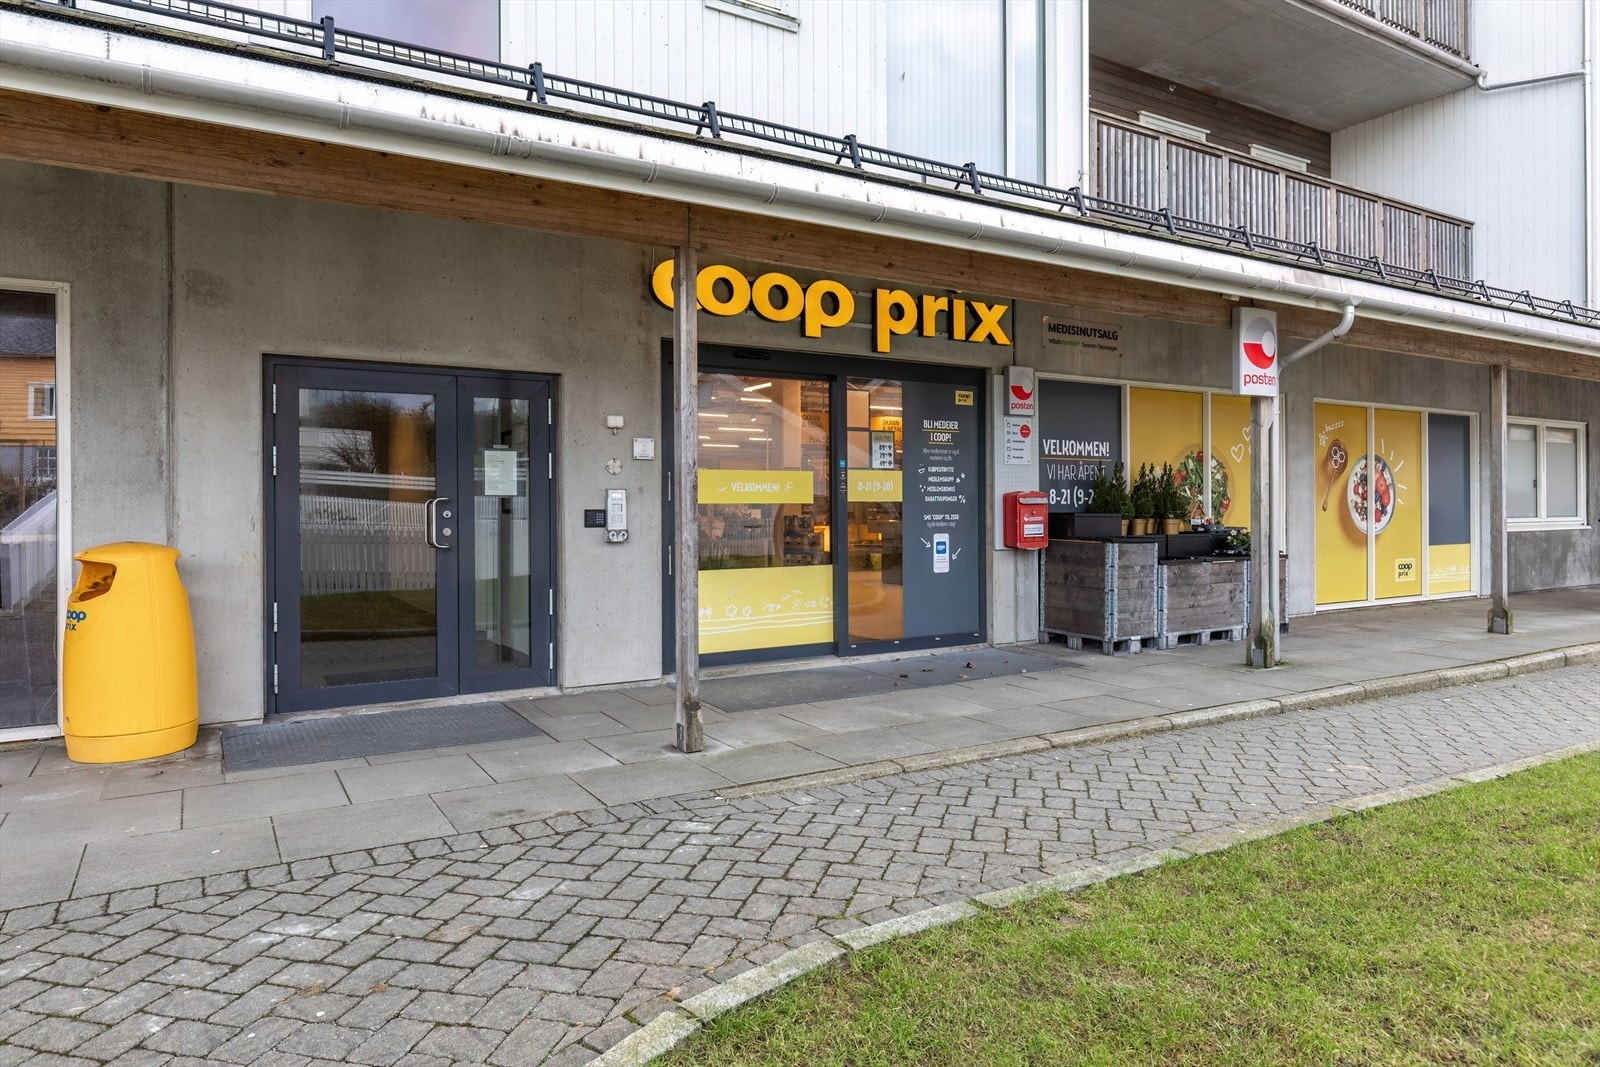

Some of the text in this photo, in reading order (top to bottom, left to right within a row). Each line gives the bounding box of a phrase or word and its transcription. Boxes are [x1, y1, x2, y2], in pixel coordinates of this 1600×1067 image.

[873, 288, 1012, 353] prix
[1048, 322, 1118, 340] MEDISINUTSALG
[1243, 371, 1276, 387] posten
[1011, 402, 1034, 410] posten
[923, 419, 959, 430] BLI MEDEIER
[933, 432, 952, 442] COOP!
[1042, 438, 1110, 457] VELKOMMEN!
[1046, 463, 1056, 480] VI
[1057, 464, 1077, 481] HAR
[731, 482, 780, 493] VELKOMMEN!
[857, 481, 872, 491] 8-21
[873, 480, 894, 493] (9-20)
[1049, 485, 1095, 508] 8-21 (9-2
[1398, 570, 1408, 578] prix
[66, 609, 87, 623] oop
